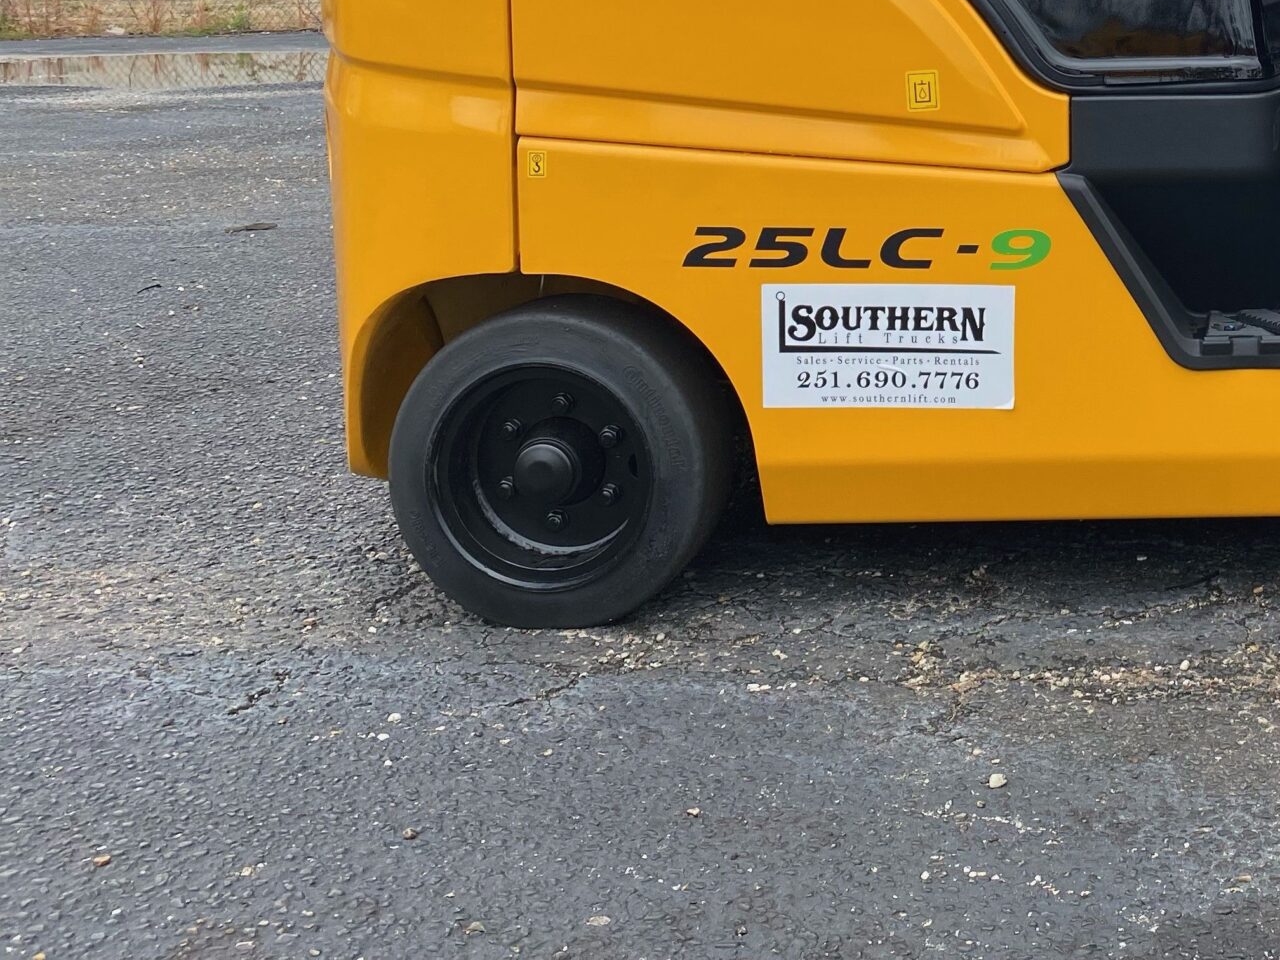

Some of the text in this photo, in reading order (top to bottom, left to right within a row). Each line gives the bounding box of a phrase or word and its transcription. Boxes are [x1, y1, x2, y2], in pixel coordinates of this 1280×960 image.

[681, 226, 1052, 271] 25LC-9
[787, 304, 986, 342] SOUTHERN
[818, 332, 959, 344] Lift Trucks
[797, 370, 980, 390] 251.690.7776
[821, 393, 956, 404] www.southernlift.com
